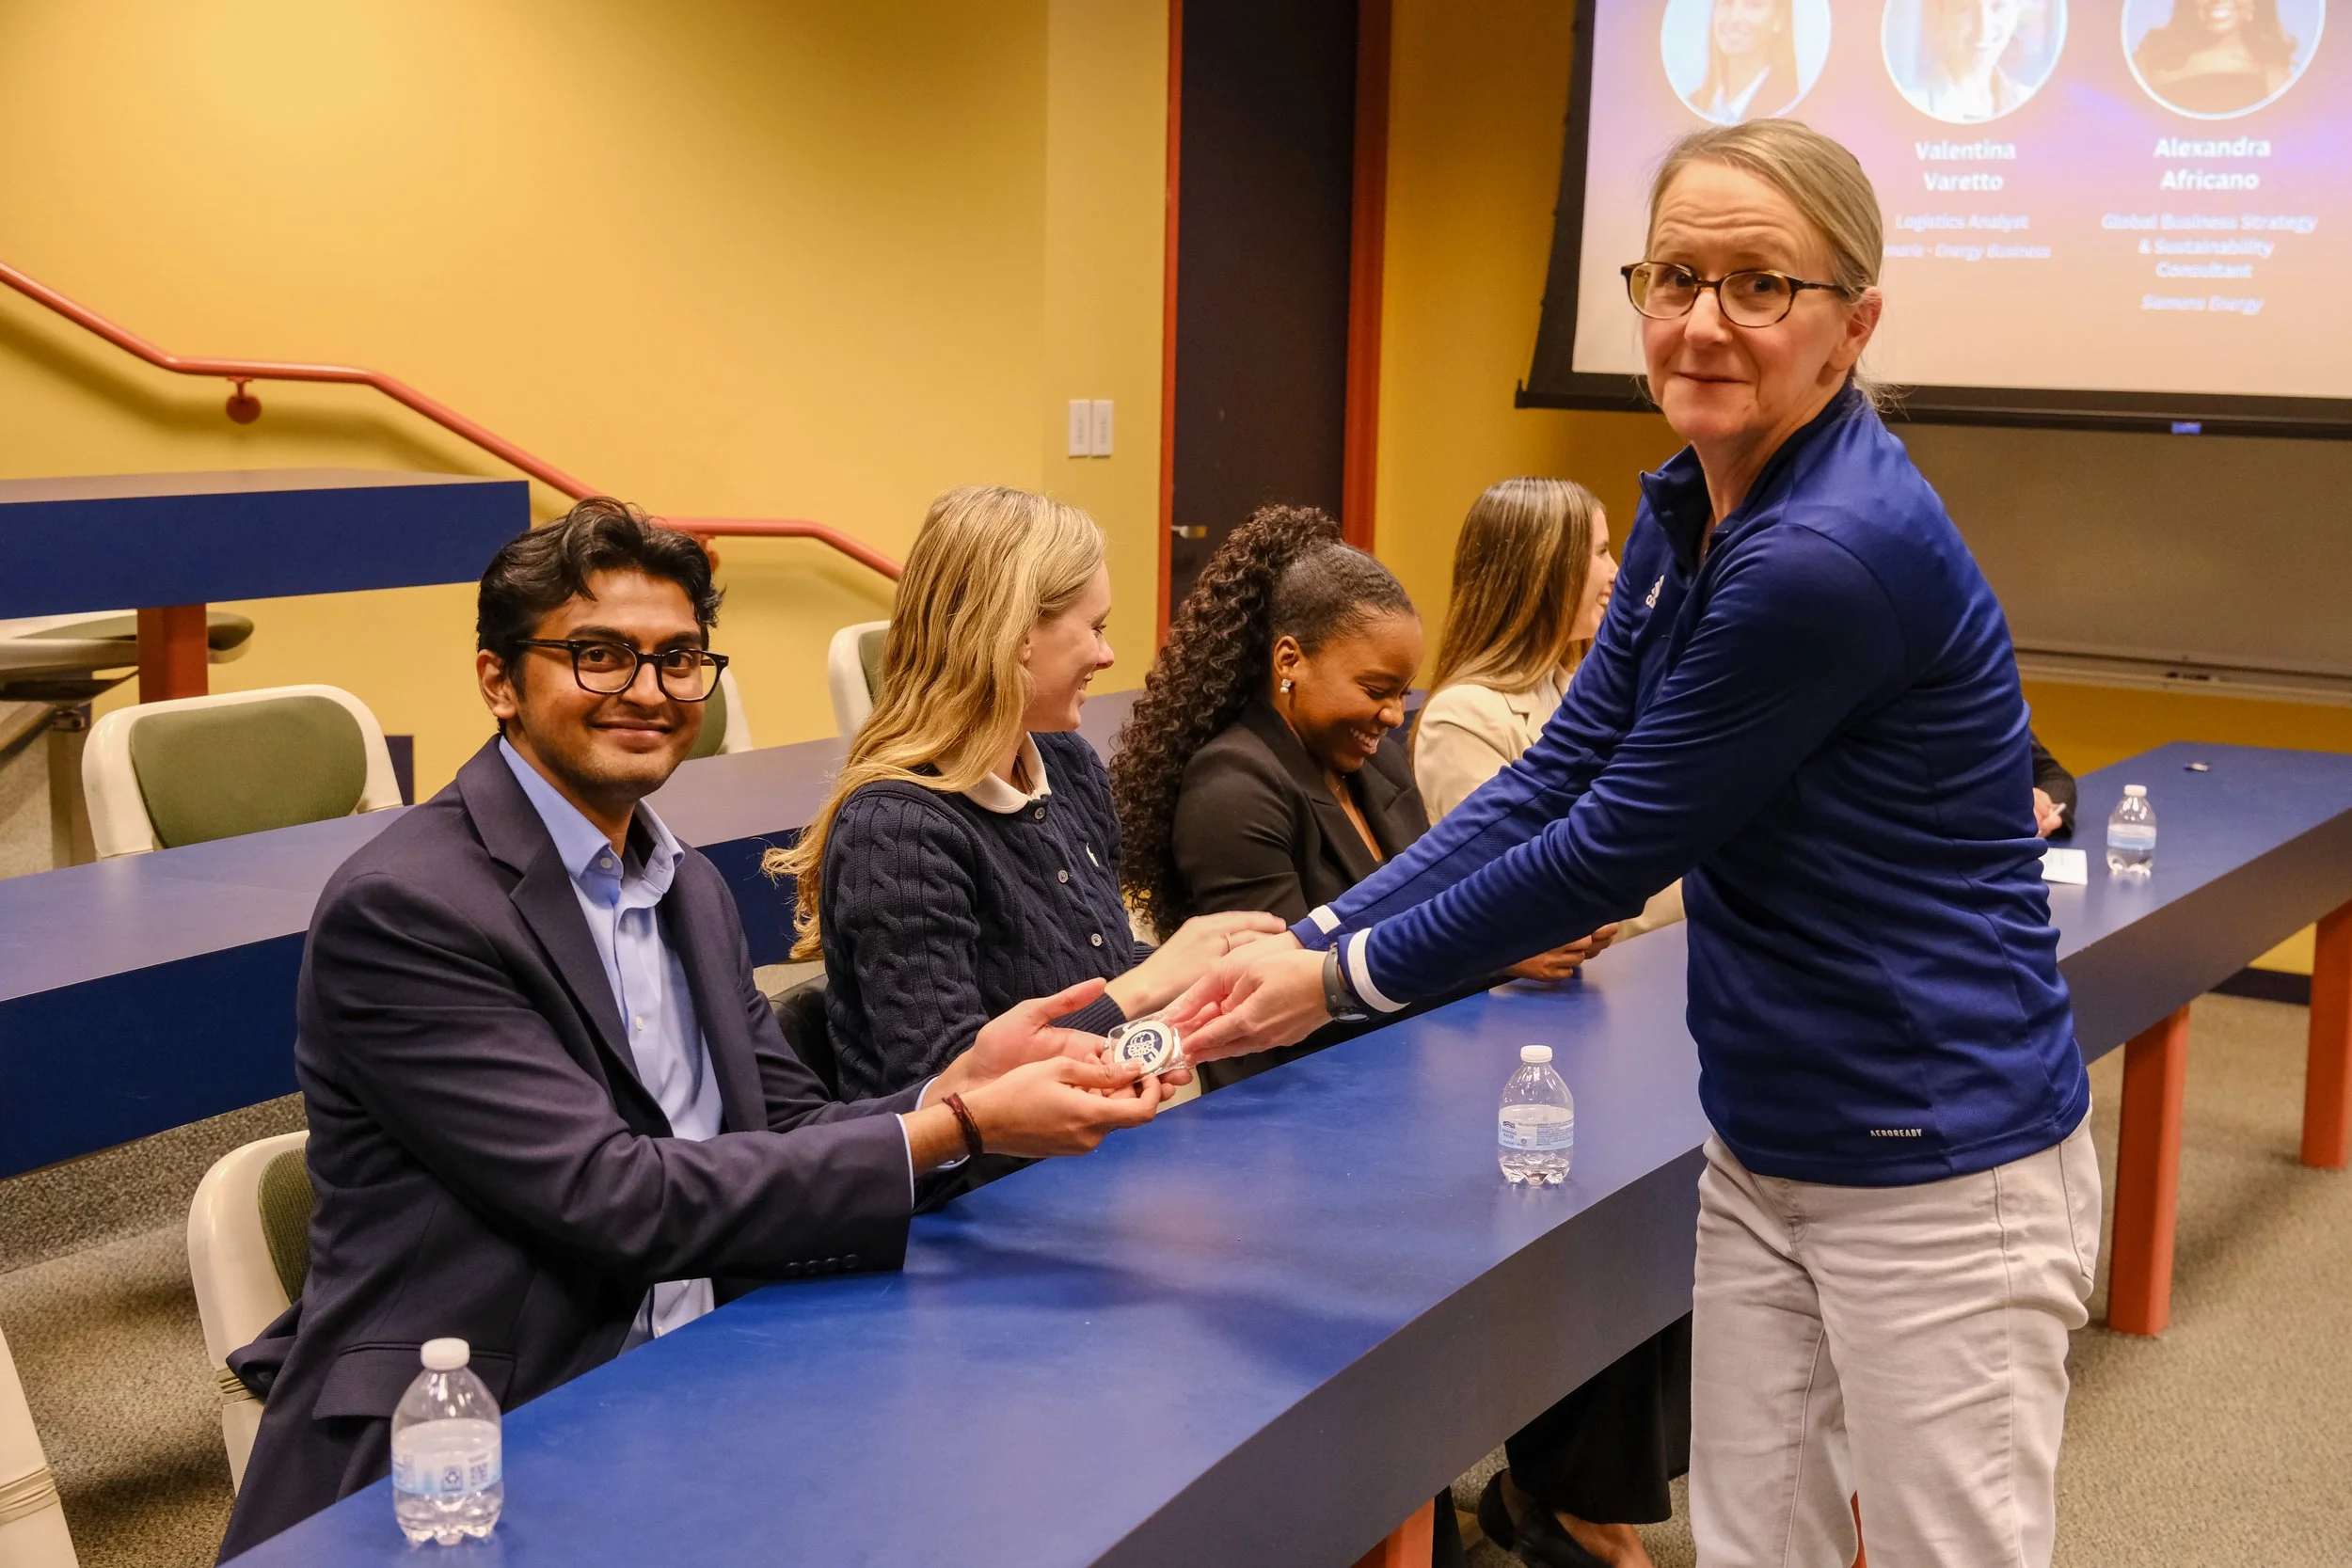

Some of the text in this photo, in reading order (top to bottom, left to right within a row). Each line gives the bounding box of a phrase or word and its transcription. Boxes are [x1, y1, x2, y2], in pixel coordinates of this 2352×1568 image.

[1915, 139, 2016, 160] Valentina
[2153, 135, 2271, 158] Alexandra
[1923, 171, 2004, 191] Varetto
[2160, 168, 2260, 191] Africano
[1896, 213, 2030, 233] Logistics Analyst
[2101, 213, 2318, 233] Global Business Strategy
[2138, 237, 2275, 259] & Sustainability
[2156, 261, 2252, 278] Consultant
[1870, 1129, 1922, 1137] AEROREADY
